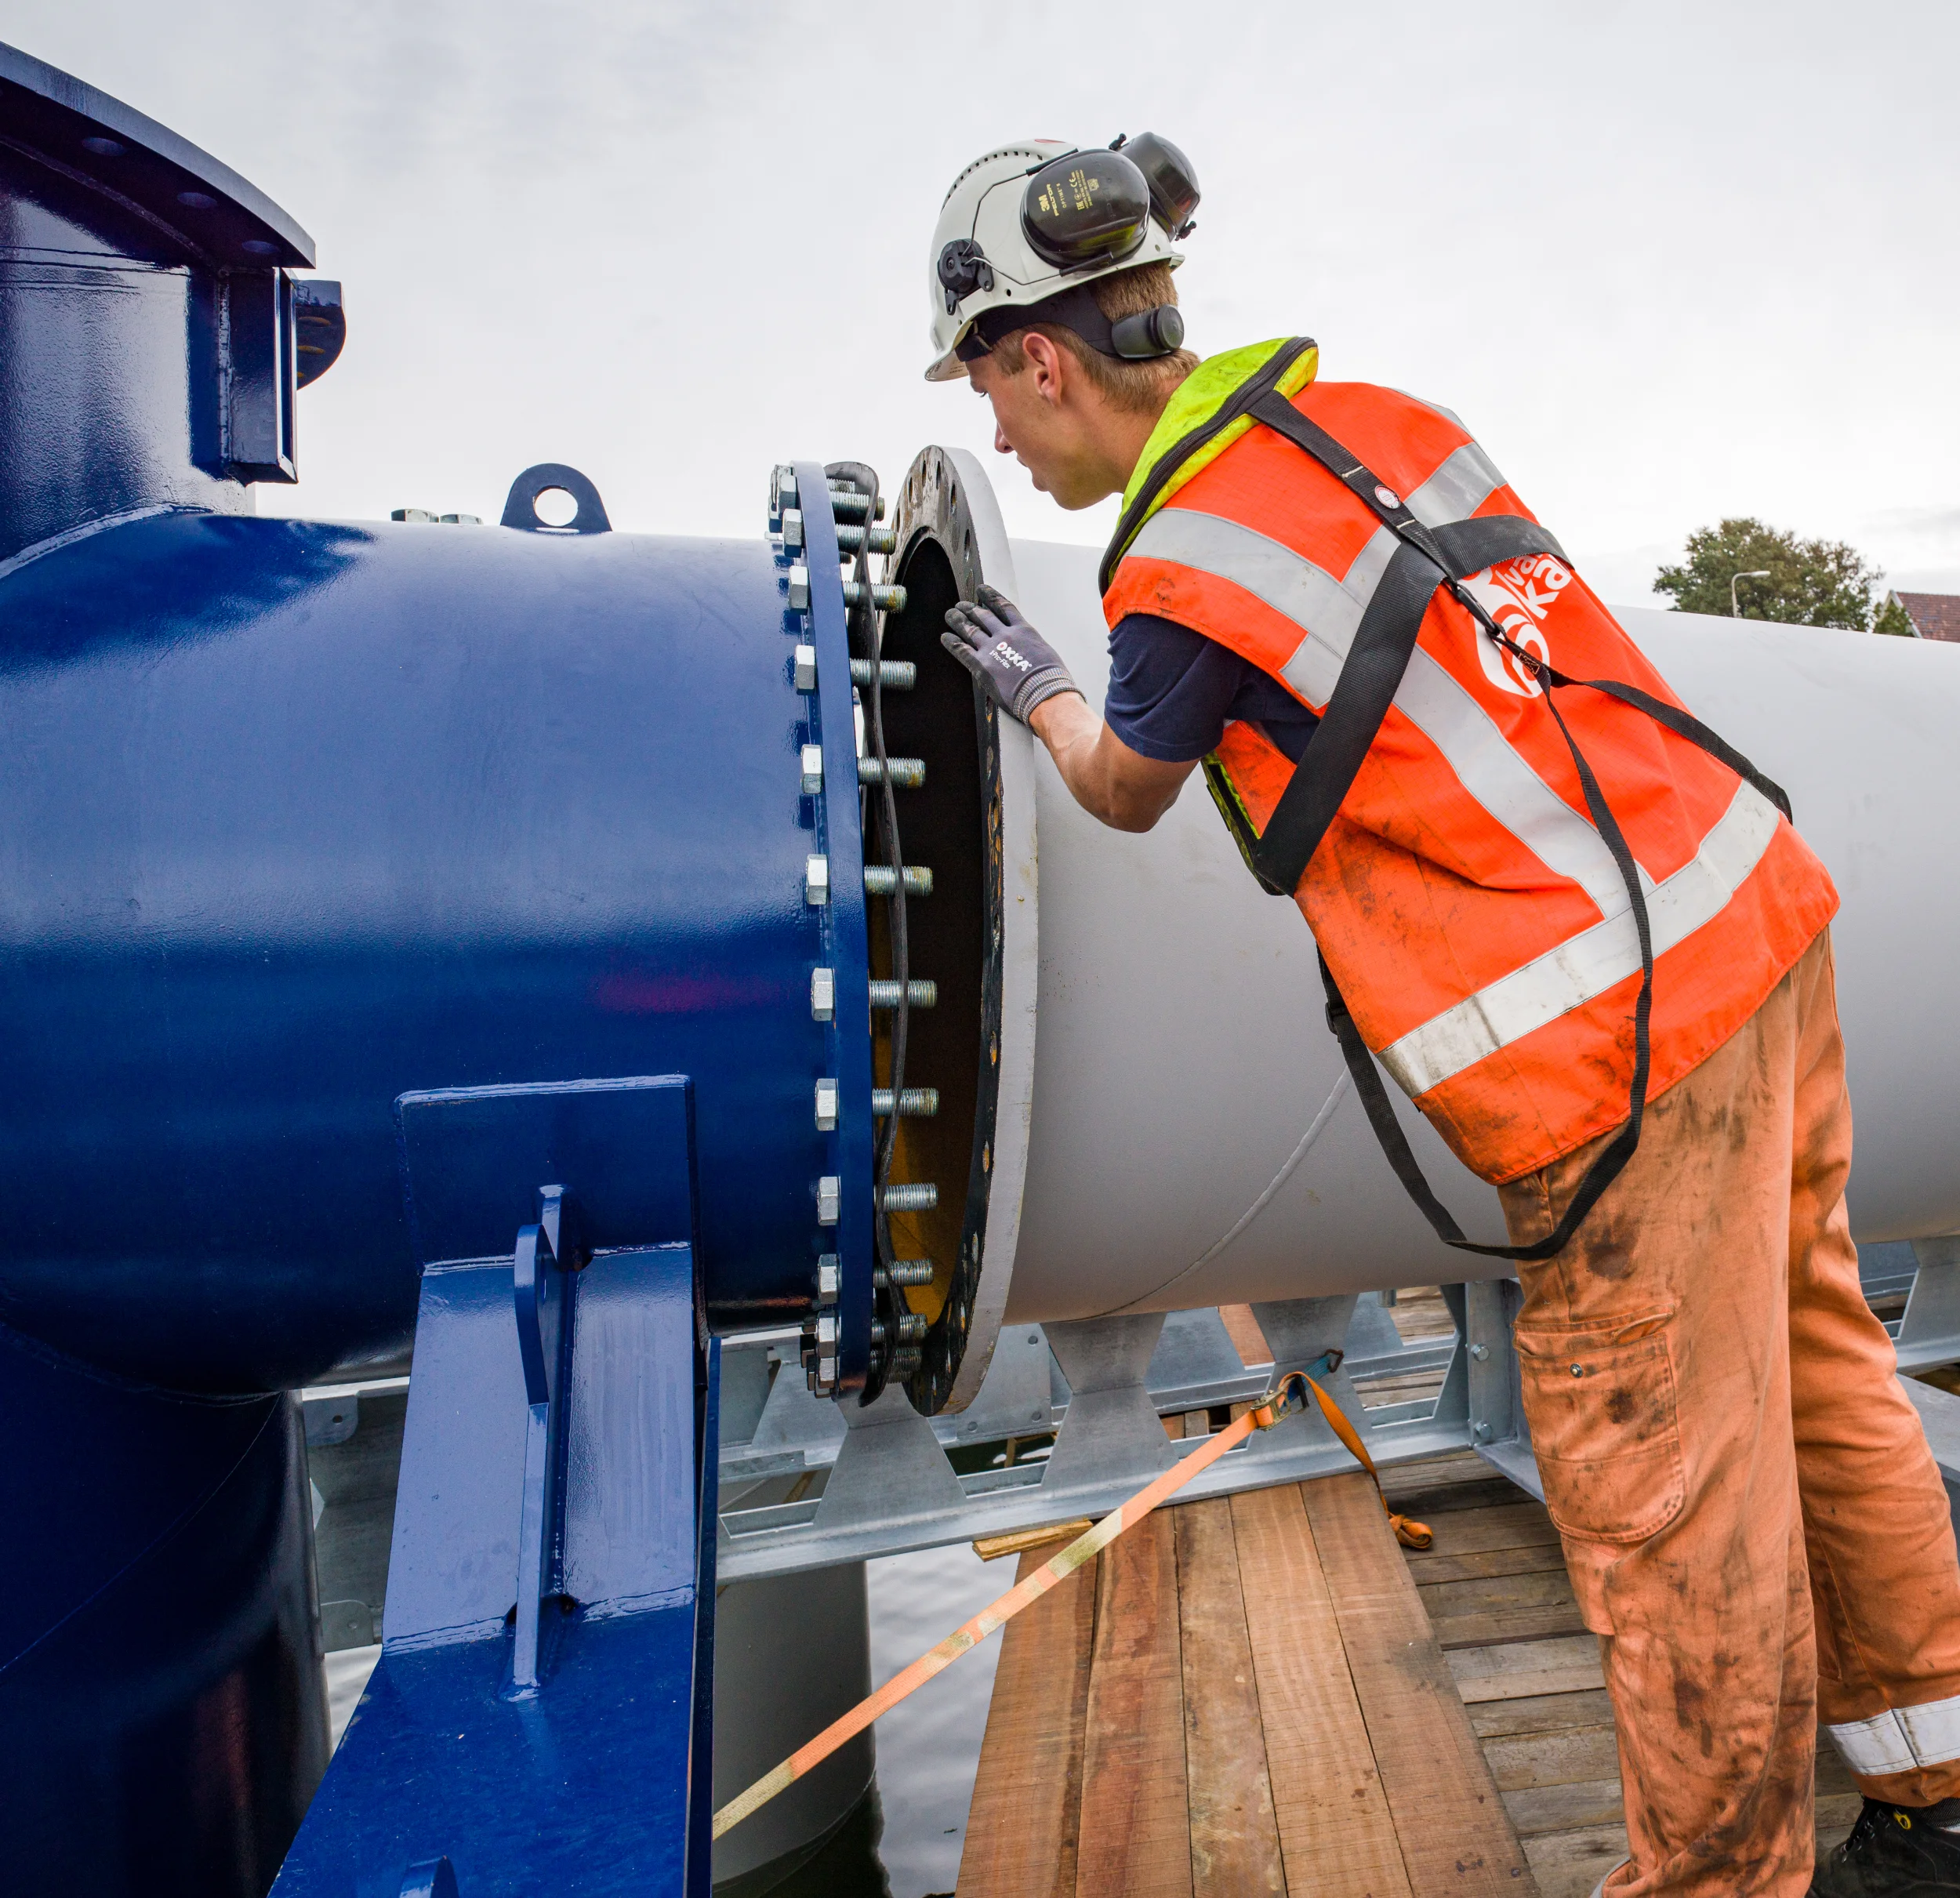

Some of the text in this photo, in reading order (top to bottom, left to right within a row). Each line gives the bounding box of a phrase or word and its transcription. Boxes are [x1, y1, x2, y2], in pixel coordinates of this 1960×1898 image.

[1038, 194, 1050, 212] 3M
[1046, 183, 1059, 216] PELTOR
[1504, 553, 1543, 586] va
[996, 641, 1030, 672] OXXA
